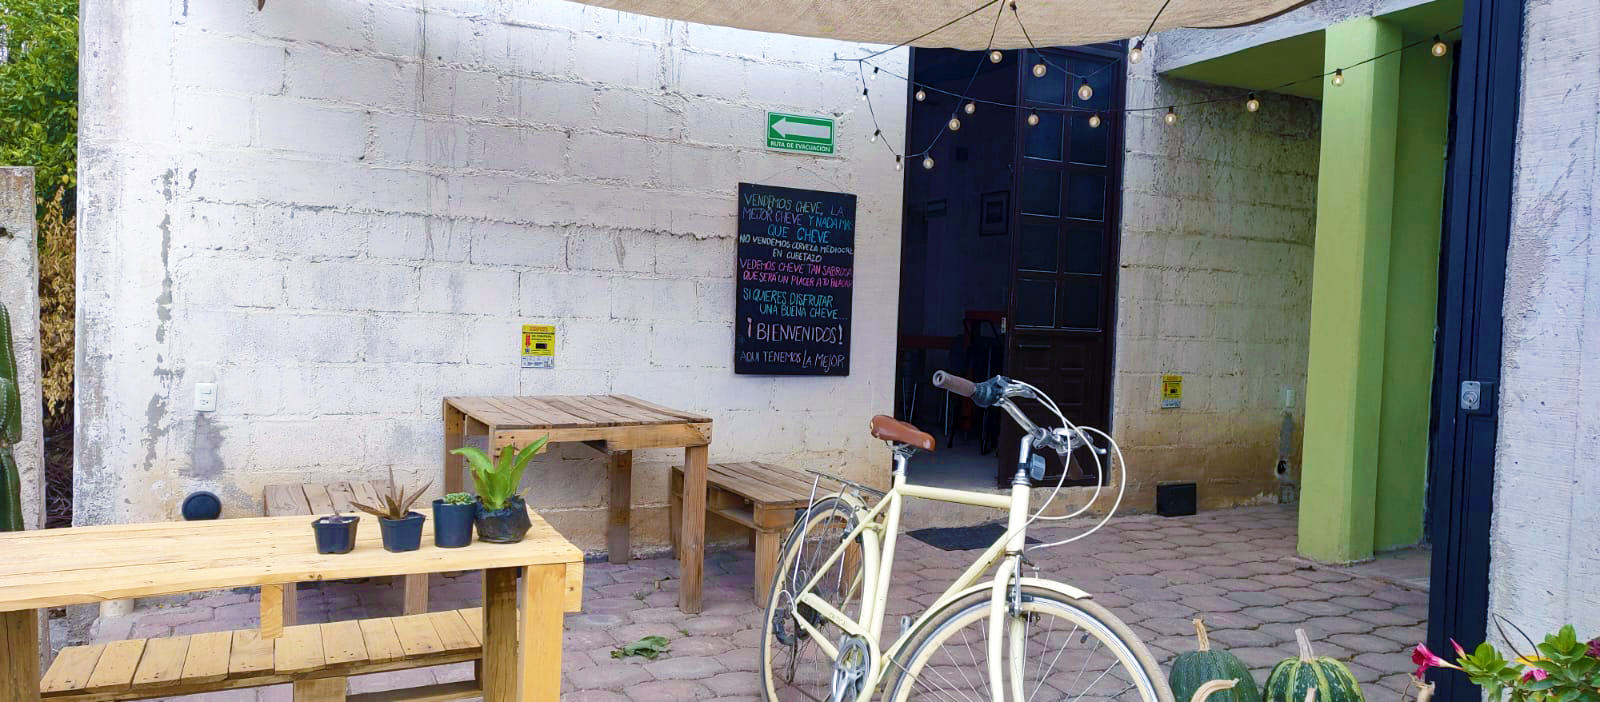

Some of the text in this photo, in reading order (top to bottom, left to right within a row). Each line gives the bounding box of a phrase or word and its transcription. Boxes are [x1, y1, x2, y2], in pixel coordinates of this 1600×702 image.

[744, 192, 793, 211] VENDEMOS
[830, 204, 844, 216] LA
[742, 206, 773, 222] MEJOR
[775, 211, 804, 226] CHEVE
[808, 214, 815, 227] Y
[816, 216, 838, 230] NADA
[740, 233, 750, 243] NO
[752, 236, 791, 249] VENDEMOS
[792, 242, 818, 252] CERVEZA
[767, 224, 832, 244] QUE CHEVE
[772, 248, 782, 258] EN
[778, 262, 804, 274] CHEVE
[808, 263, 821, 275] TAN
[743, 270, 758, 281] QUE
[778, 274, 789, 285] UN
[816, 277, 822, 288] A
[743, 288, 834, 308] SI QUIERES DISFRUTAR
[760, 304, 778, 315] UNA
[781, 305, 807, 318] BUENA
[763, 350, 801, 364] TENEMOS
[801, 349, 812, 368] LA
[815, 352, 846, 373] MEJOR
